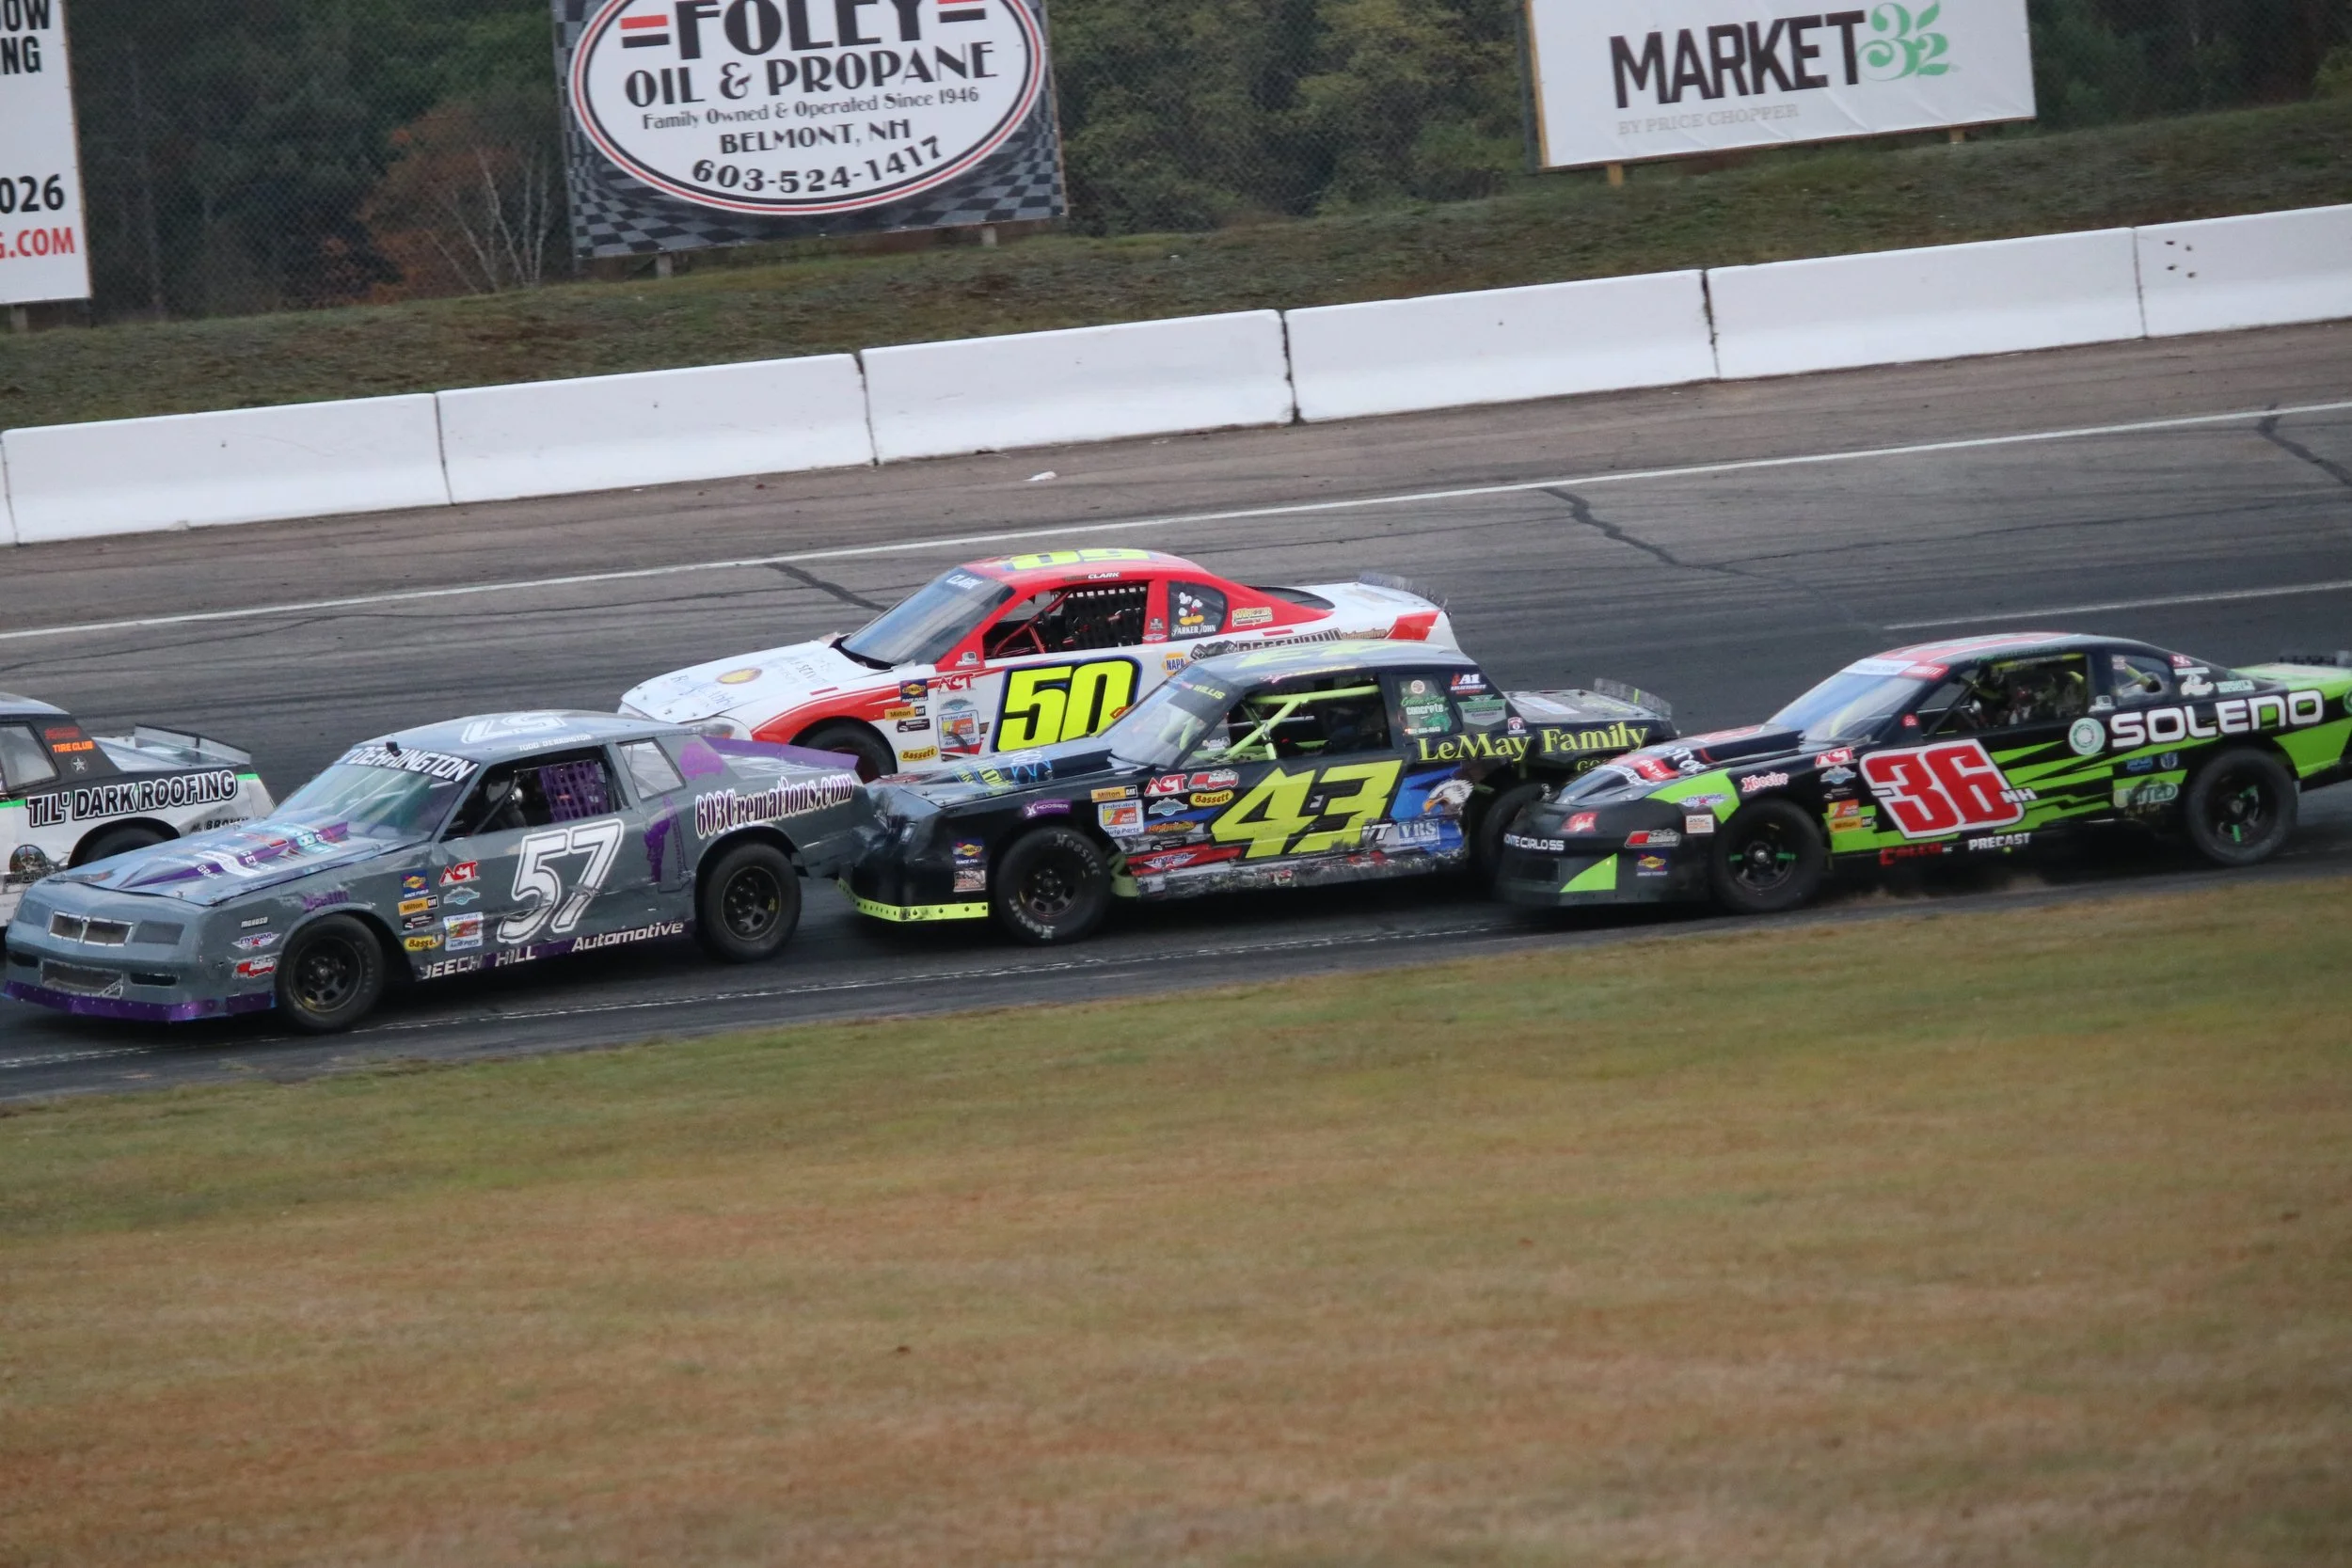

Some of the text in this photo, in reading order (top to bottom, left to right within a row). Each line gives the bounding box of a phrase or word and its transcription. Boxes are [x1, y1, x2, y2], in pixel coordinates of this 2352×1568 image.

[0, 0, 50, 32] OW
[675, 0, 922, 59] FOLEY
[0, 36, 41, 75] NG
[1610, 9, 1867, 109] MARKET
[625, 41, 999, 108] OIL & PROPANE
[643, 86, 979, 130] Family Owned & Operated Since 1946
[1618, 103, 1801, 135] BY PRICE CHOPPER
[720, 119, 912, 155] BELMONT, NH
[691, 135, 943, 195] 603-524-1417
[1087, 571, 1120, 579] CLARK
[1171, 623, 1216, 637] PARKER JOHN
[1167, 657, 1185, 671] NAPA
[937, 673, 976, 693] ACT
[1192, 684, 1227, 700] WILLIS
[993, 657, 1138, 752] 50
[52, 743, 72, 753] TIRE
[902, 748, 935, 760] Bassett
[1417, 733, 1533, 763] LeMay
[1540, 721, 1648, 751] Family
[1097, 790, 1121, 799] Milton
[1740, 771, 1789, 793] Hoosier
[1859, 737, 2026, 840] 36
[1999, 786, 2039, 804] NH
[26, 769, 239, 828] TIL' DARK ROOFING
[694, 772, 854, 840] 603Cremations.com
[1036, 801, 1070, 811] HOOSIER
[1194, 792, 1230, 803] Bassett
[1210, 759, 1404, 860] 43
[1549, 839, 1565, 851] SS
[1967, 832, 2031, 851] PRECAST
[496, 817, 625, 944] 57
[403, 902, 423, 911] Milton
[408, 936, 442, 949] Basse
[570, 921, 685, 953] Automotive
[494, 945, 538, 968] HILL
